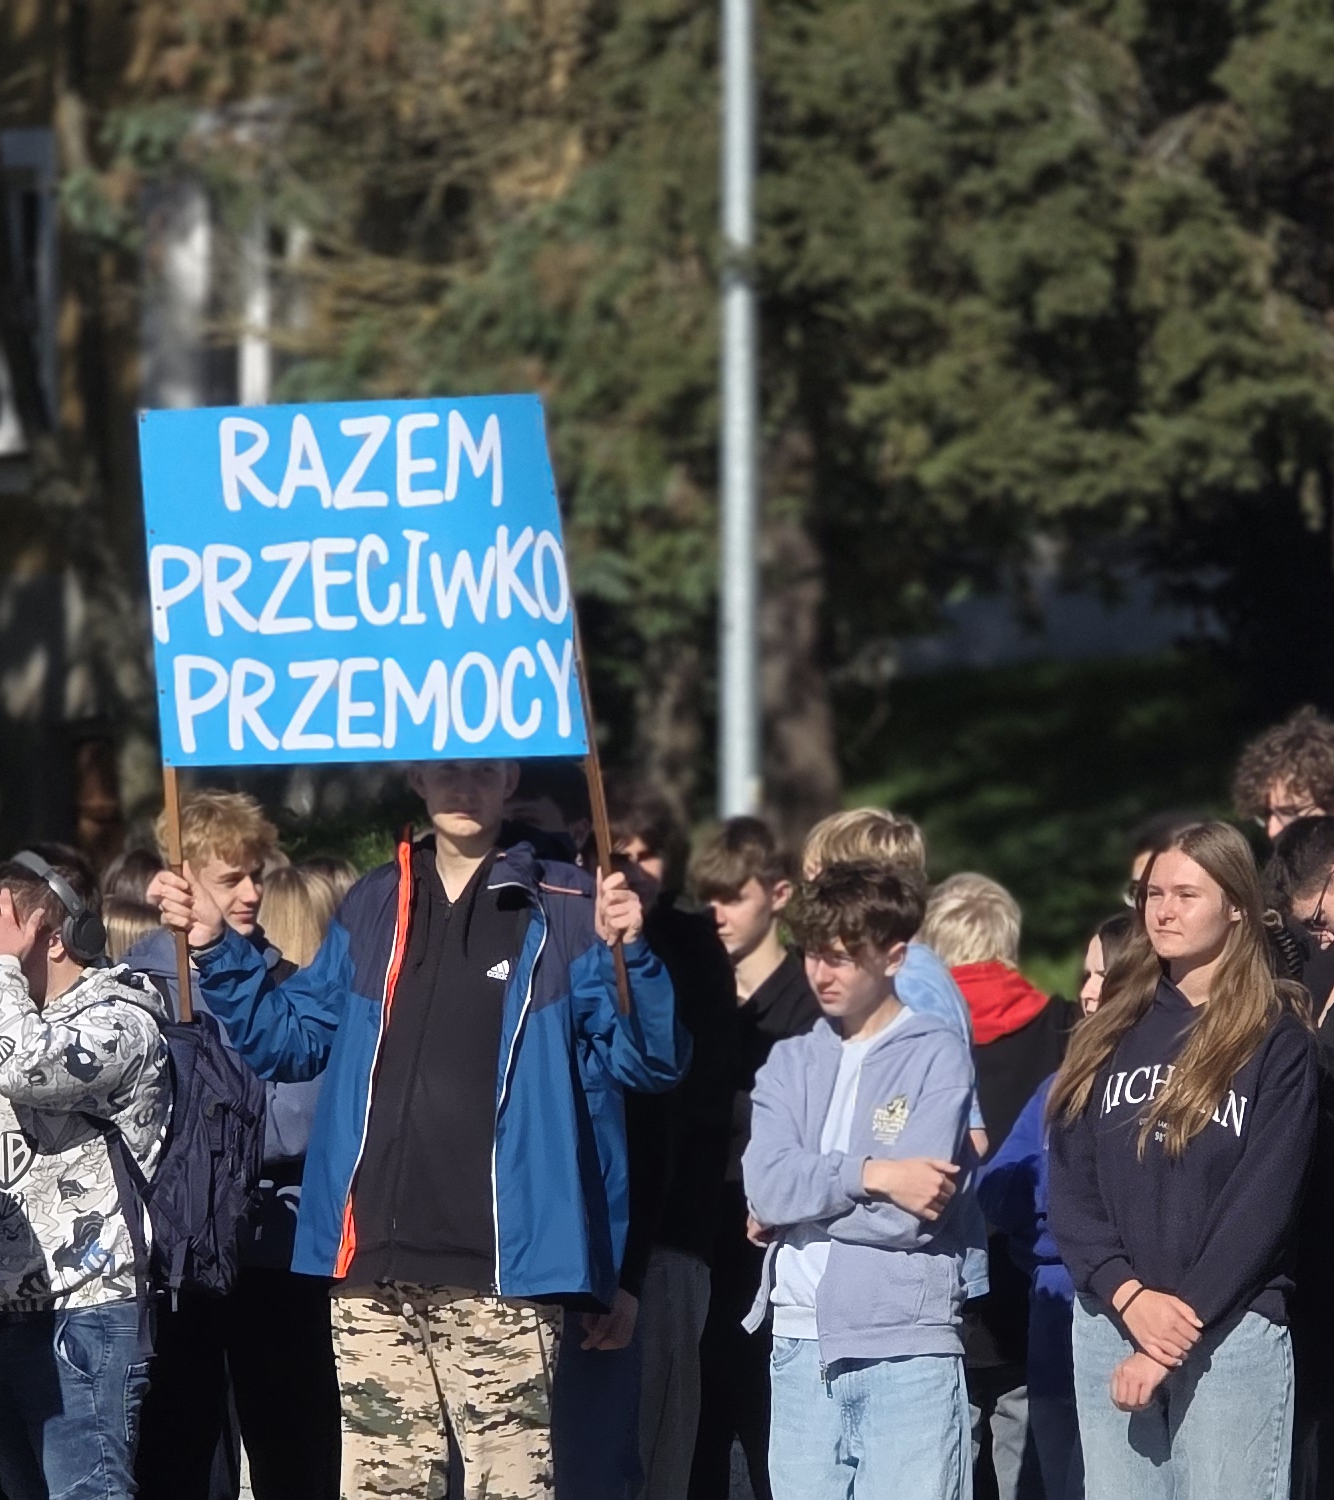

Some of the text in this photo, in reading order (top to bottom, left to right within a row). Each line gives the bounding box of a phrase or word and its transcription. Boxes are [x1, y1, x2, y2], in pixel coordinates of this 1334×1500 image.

[219, 410, 503, 511] RAZEM
[149, 525, 570, 643] PRZECIWKO
[173, 638, 573, 753] PRZEMOCY
